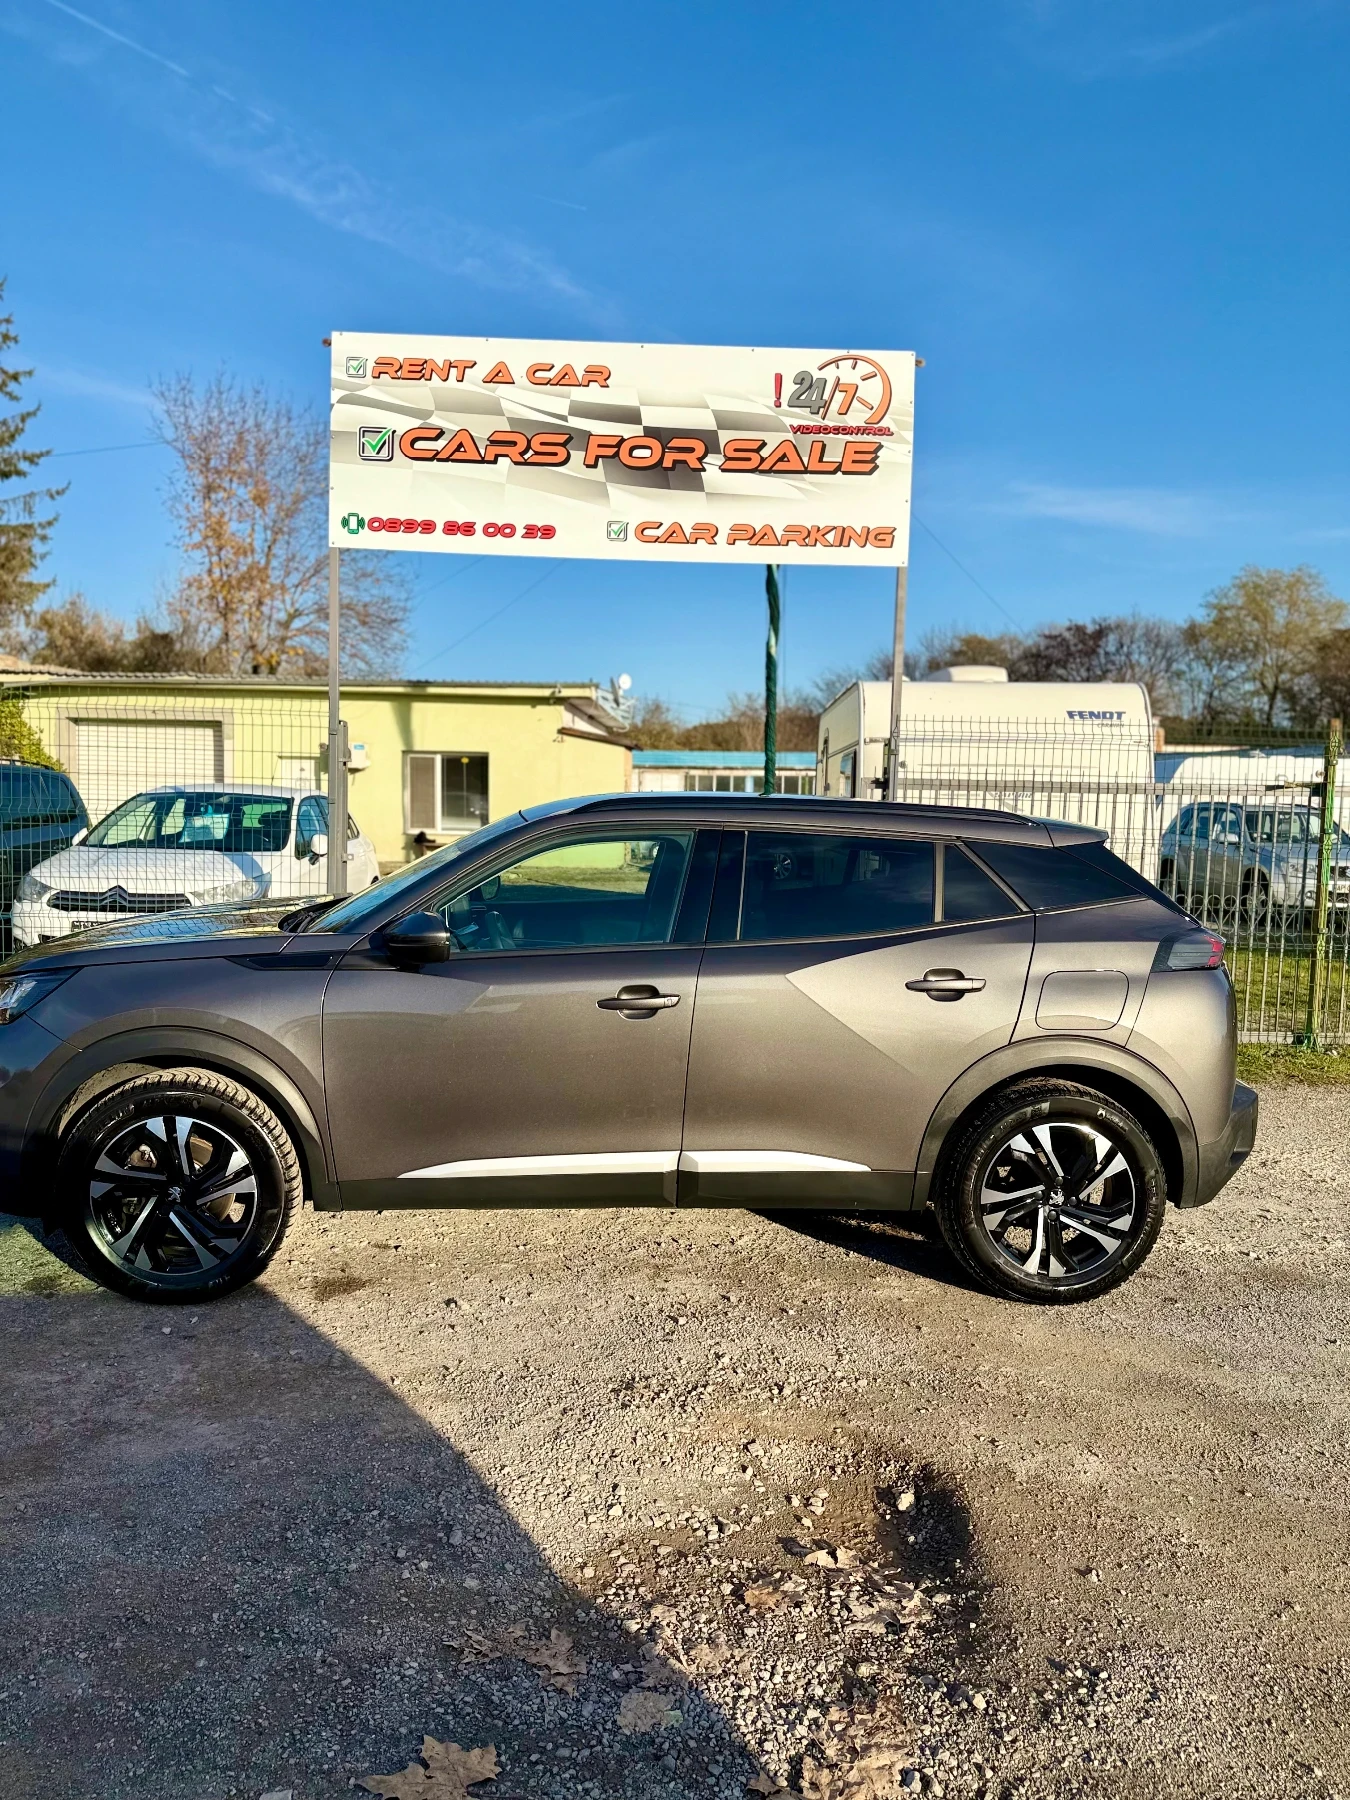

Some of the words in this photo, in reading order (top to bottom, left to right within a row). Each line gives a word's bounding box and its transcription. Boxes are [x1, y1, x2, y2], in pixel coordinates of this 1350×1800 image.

[372, 356, 477, 383] RENT
[482, 361, 515, 384] A
[526, 362, 611, 388] CAR
[789, 424, 894, 436] VIDEOCONTROL
[399, 427, 574, 467] CARS
[583, 434, 709, 472] FOR
[718, 438, 884, 475] SALE
[367, 516, 437, 535] 0899
[442, 520, 476, 537] 86
[482, 522, 517, 538] 00
[521, 524, 557, 540] 39
[634, 521, 718, 545] CAR
[726, 523, 897, 548] PARKING
[1066, 710, 1126, 720] FENDT
